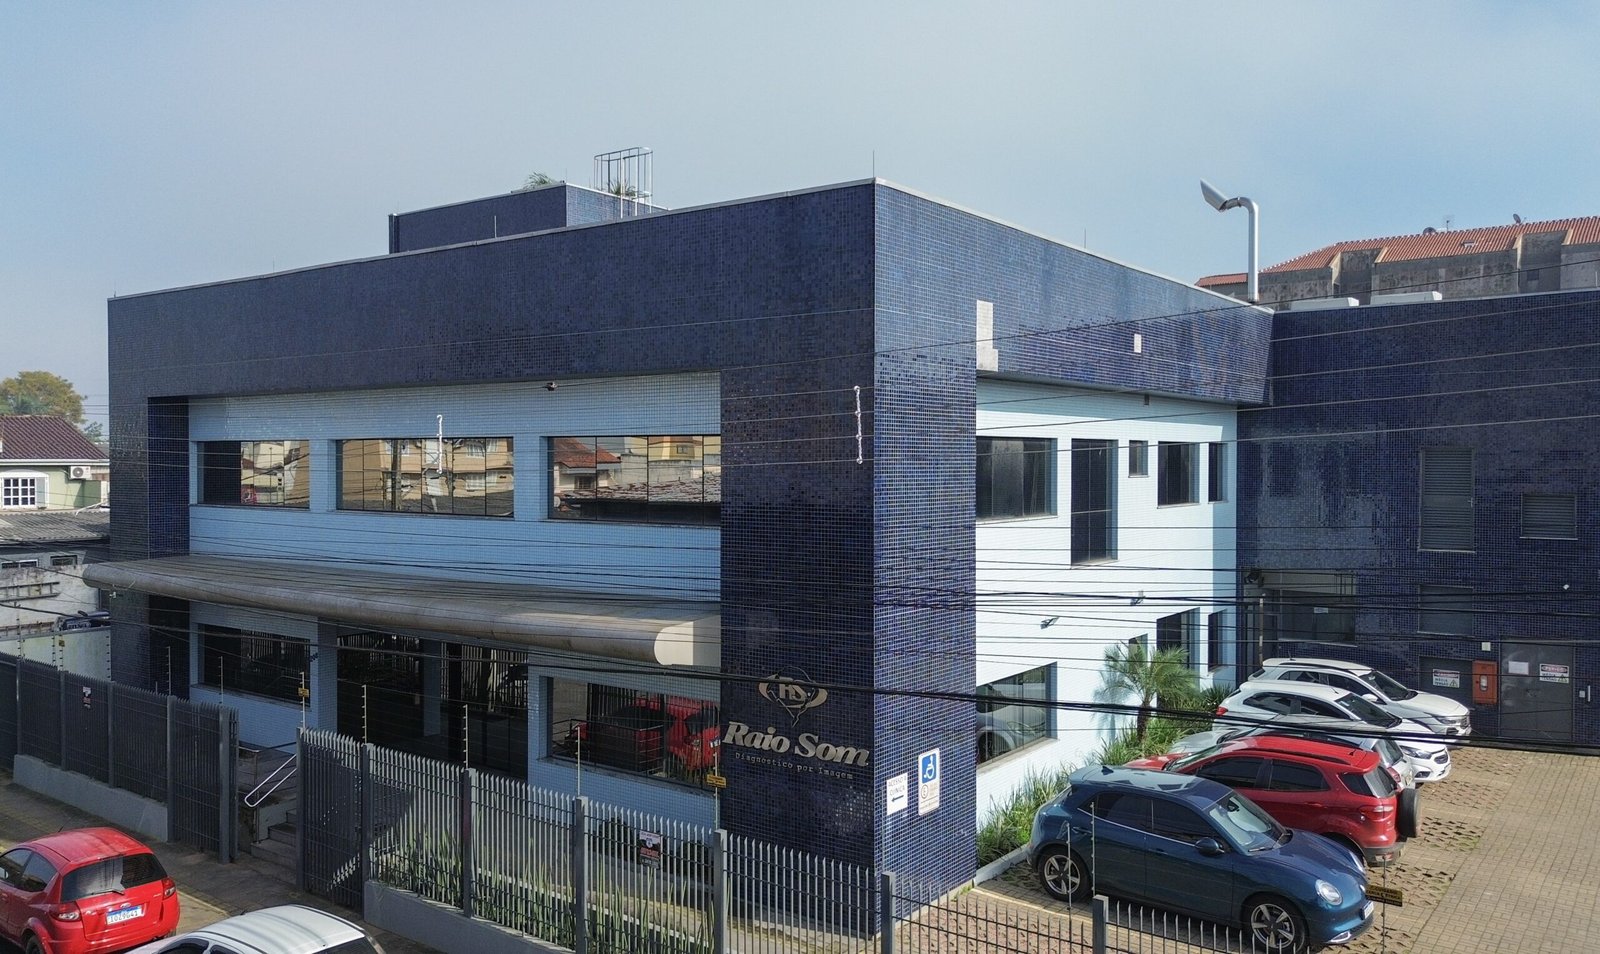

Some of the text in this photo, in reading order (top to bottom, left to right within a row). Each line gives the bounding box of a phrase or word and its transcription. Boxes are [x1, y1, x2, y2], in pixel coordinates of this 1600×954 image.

[722, 721, 869, 767] Raio Som
[796, 764, 814, 773] por
[818, 767, 854, 780] Imagem
